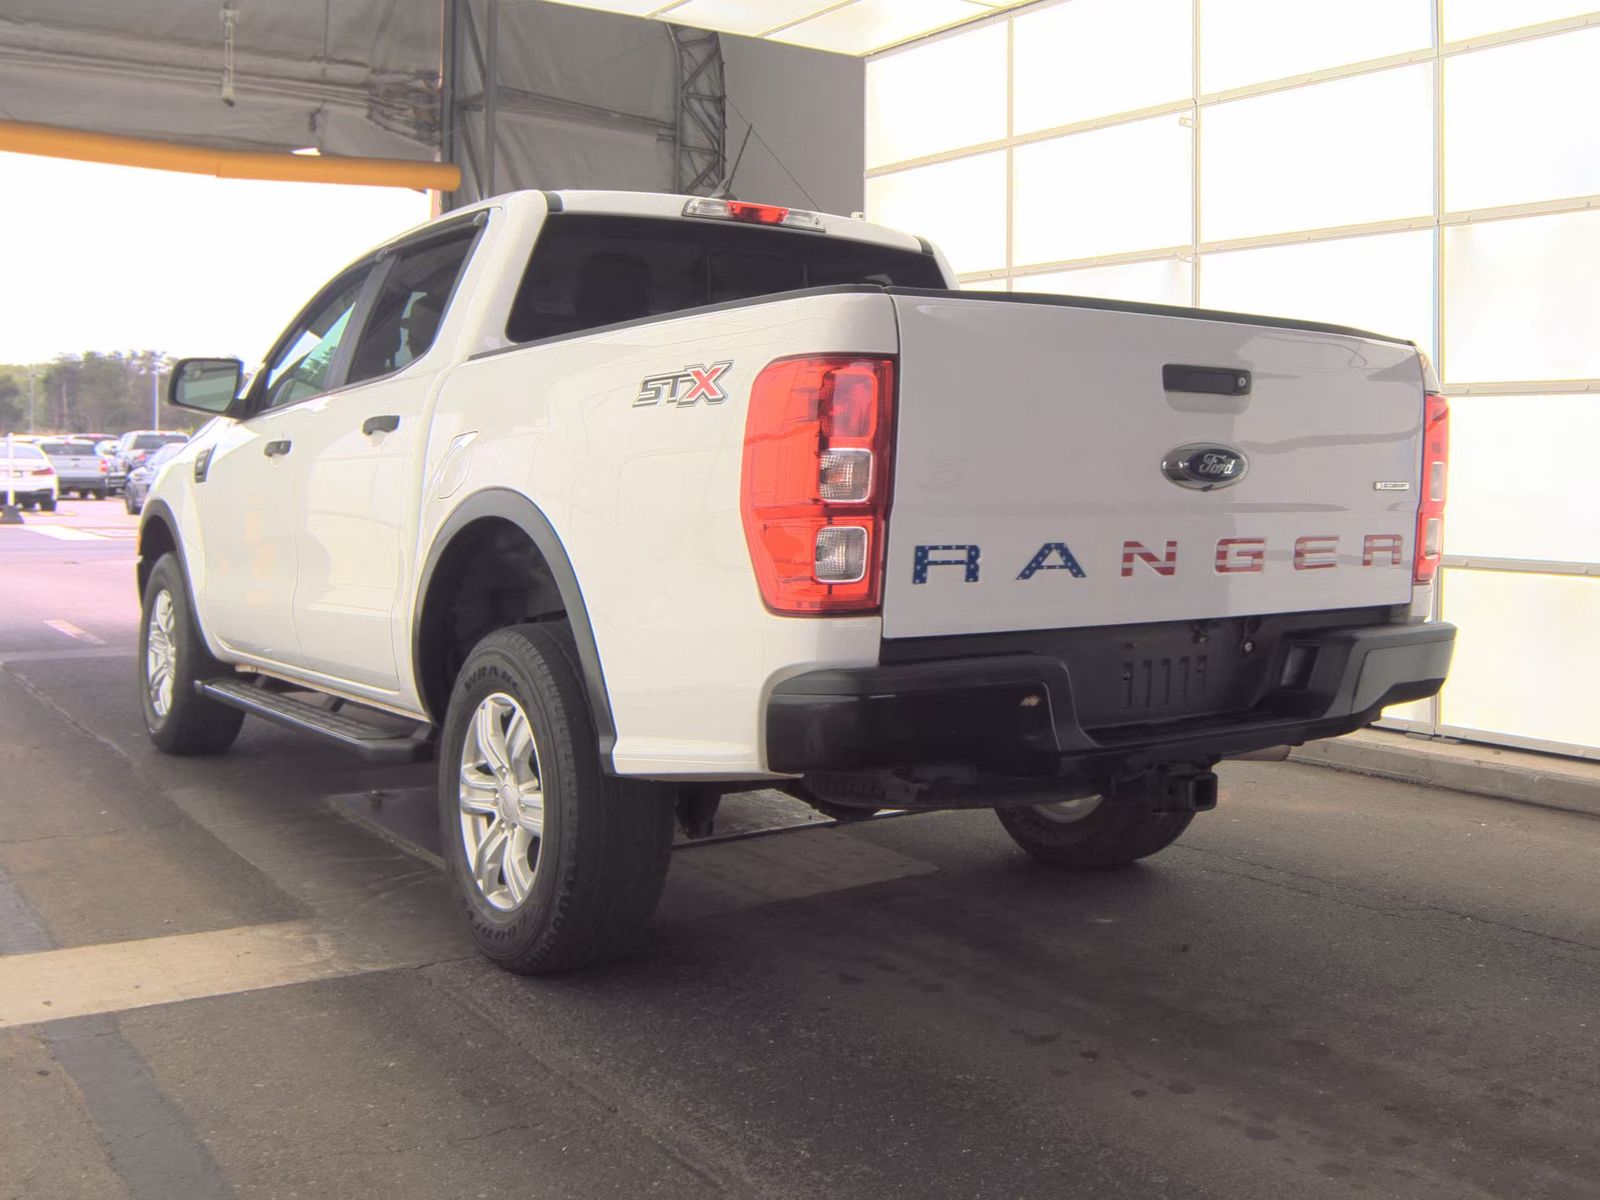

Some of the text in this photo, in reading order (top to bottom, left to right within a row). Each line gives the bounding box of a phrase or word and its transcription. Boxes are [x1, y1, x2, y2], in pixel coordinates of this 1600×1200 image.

[632, 359, 735, 408] STX
[1199, 453, 1235, 475] Ford
[912, 534, 1404, 584] RANGER
